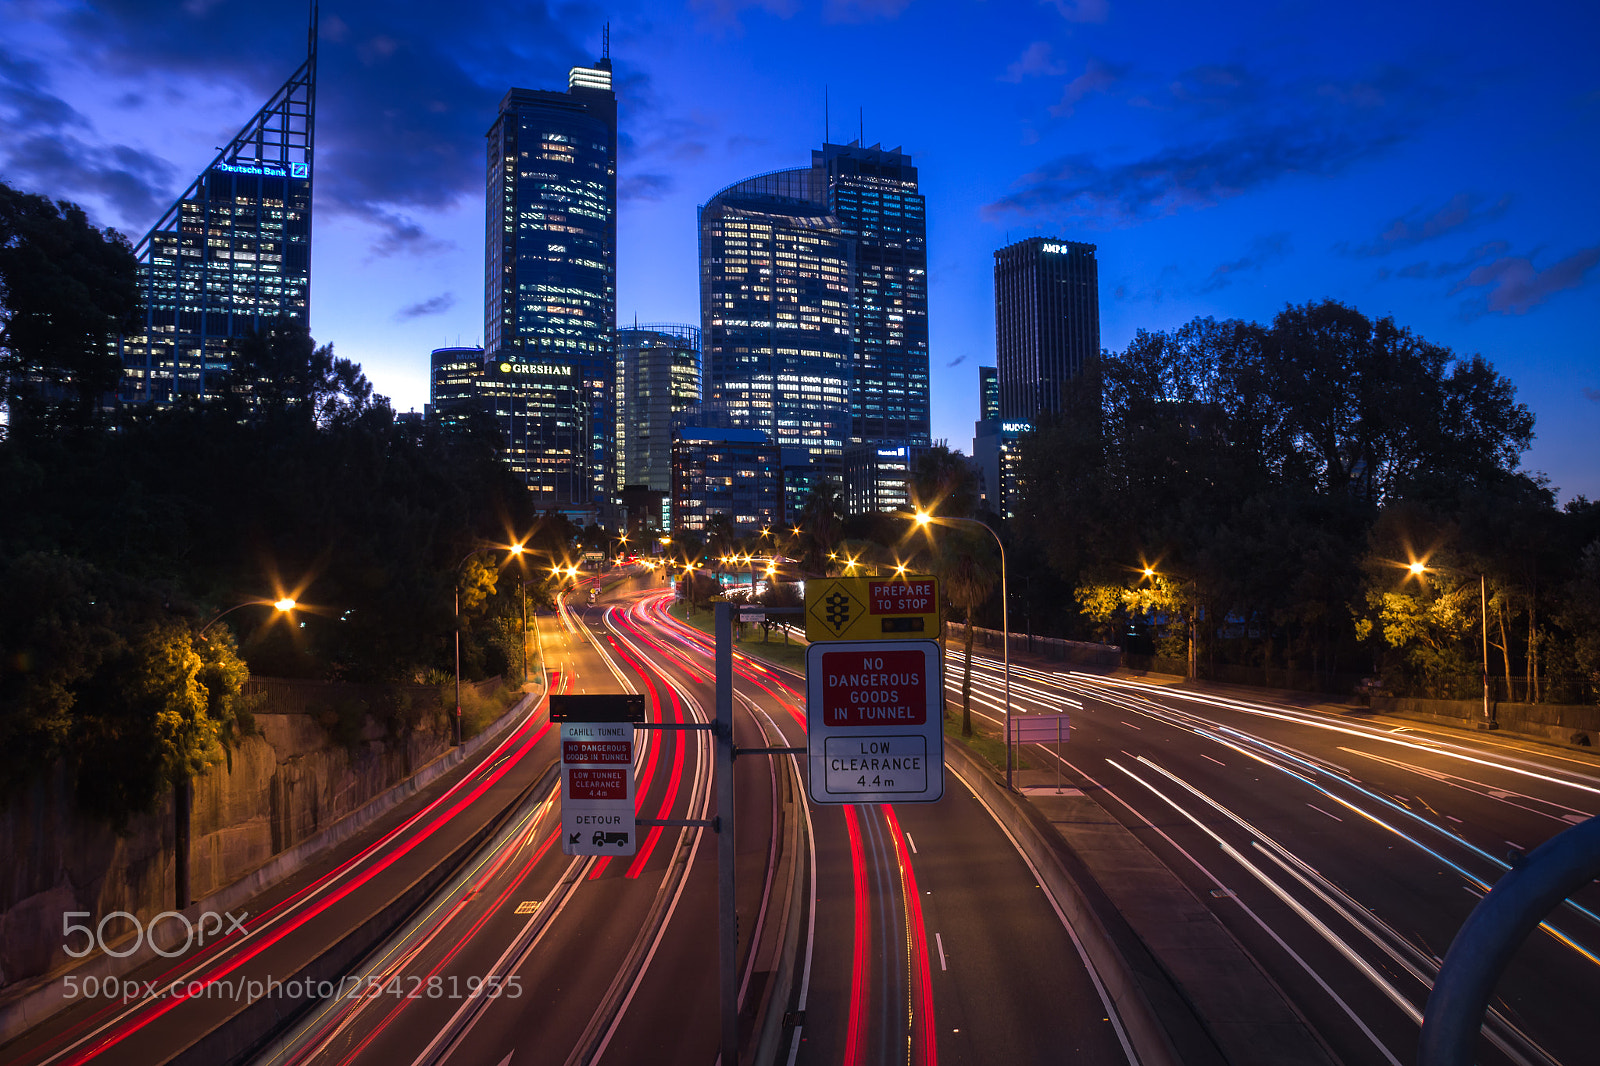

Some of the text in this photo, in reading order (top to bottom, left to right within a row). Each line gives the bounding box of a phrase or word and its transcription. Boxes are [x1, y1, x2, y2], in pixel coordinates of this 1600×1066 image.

[221, 163, 286, 177] Deutsche Bank
[512, 364, 571, 376] GRESHAM
[874, 585, 931, 596] PREPARE
[877, 599, 928, 610] TO STOP
[864, 658, 884, 670] NO
[829, 673, 919, 688] DANGEROUS
[850, 690, 899, 703] GOODS
[834, 706, 915, 720] IN TUNNEL
[569, 728, 626, 736] CAHILL TUNNEL
[581, 744, 627, 752] DANGEROUS
[860, 742, 890, 754] LOW
[832, 758, 920, 771] CLEARANCE
[576, 816, 621, 825] DETOUR
